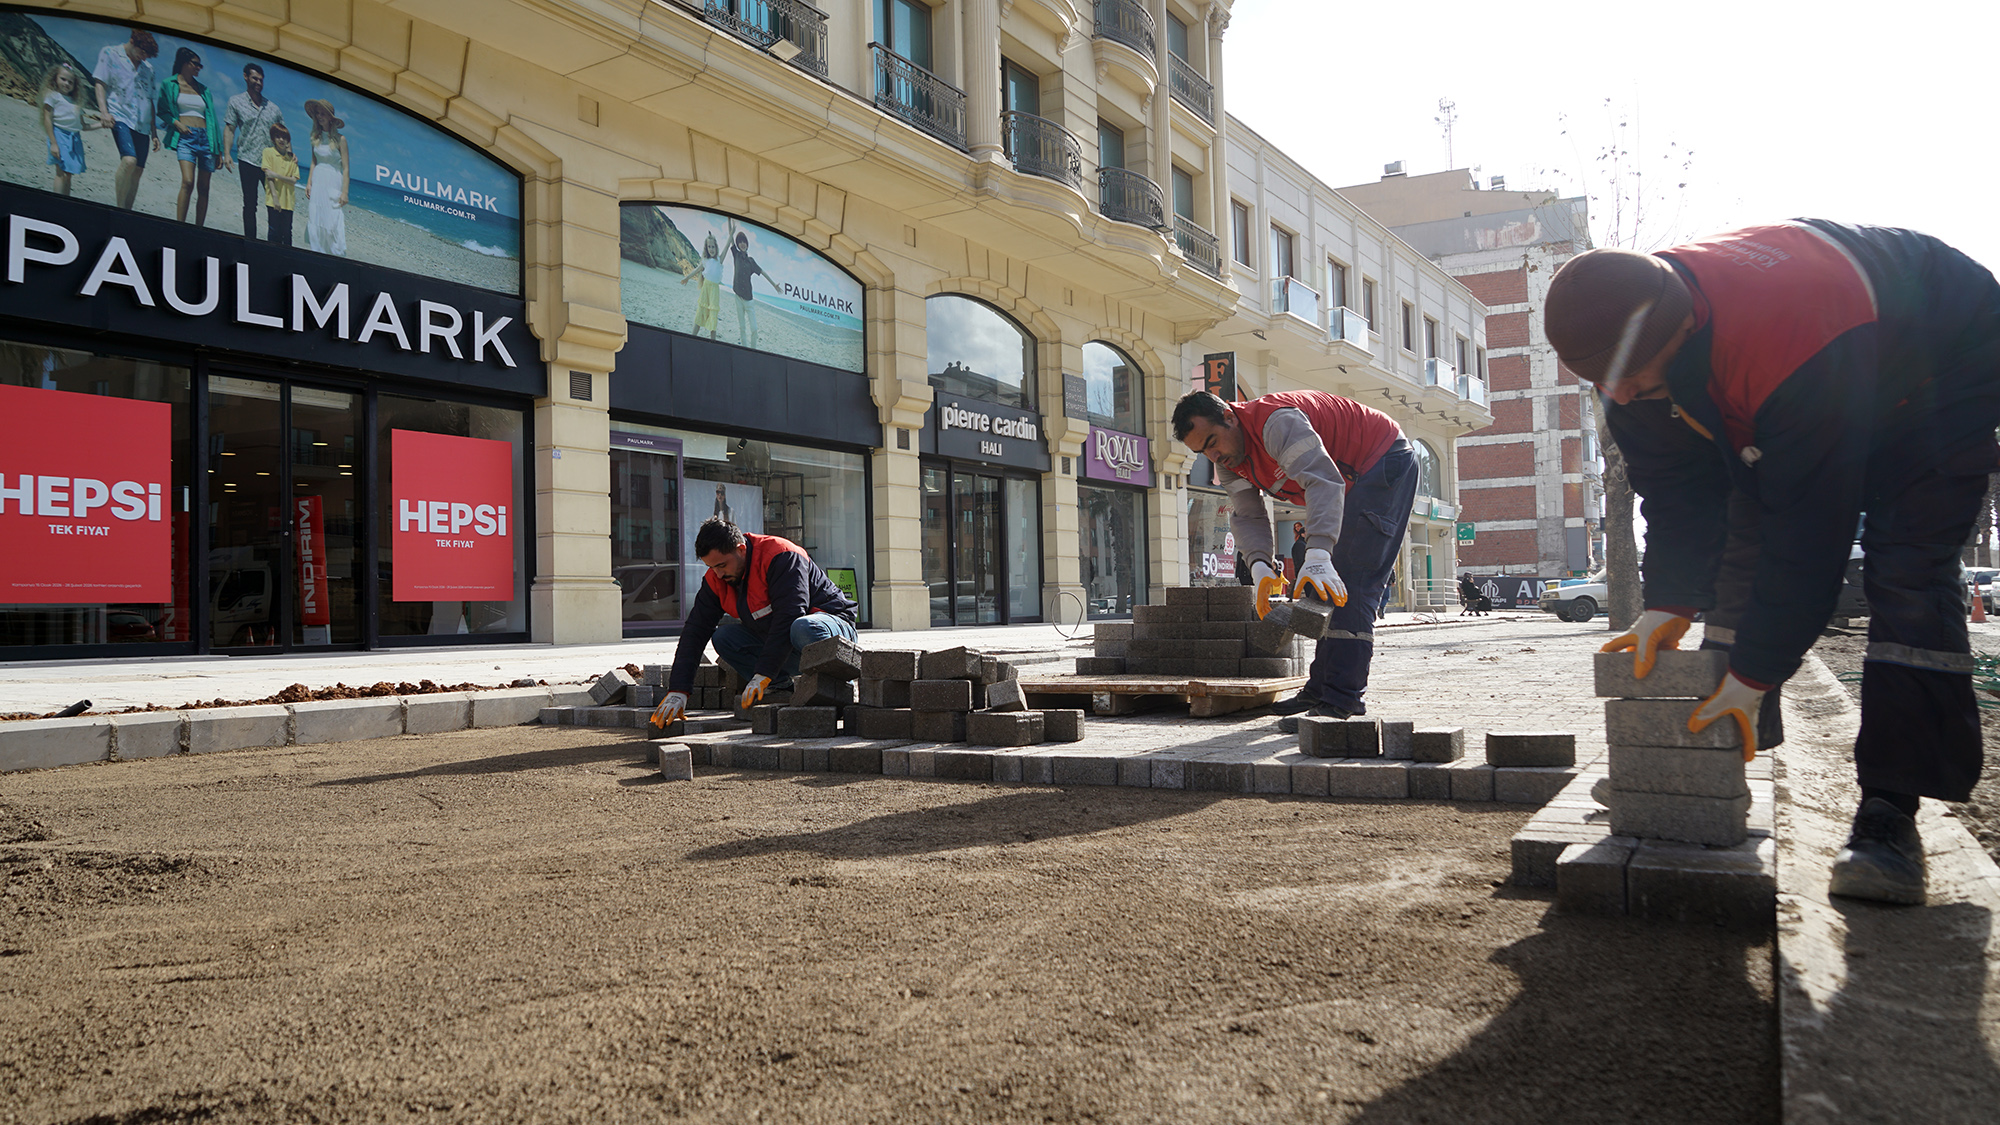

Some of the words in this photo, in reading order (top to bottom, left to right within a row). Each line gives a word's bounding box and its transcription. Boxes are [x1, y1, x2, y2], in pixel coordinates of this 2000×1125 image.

[375, 164, 499, 213] PAULMARK
[403, 195, 476, 221] PAULMARK.COM.TR
[7, 213, 517, 367] PAULMARK
[784, 282, 854, 315] PAULMARK
[799, 304, 840, 320] PAULMARK.COM.TR
[941, 402, 990, 432] pierre
[992, 416, 1037, 441] cardin
[626, 437, 655, 446] PAULMARK
[981, 440, 1003, 456] HALI
[1094, 430, 1145, 471] ROYAL
[49, 524, 73, 535] TEK
[436, 539, 452, 548] TEK
[1202, 553, 1218, 576] 50
